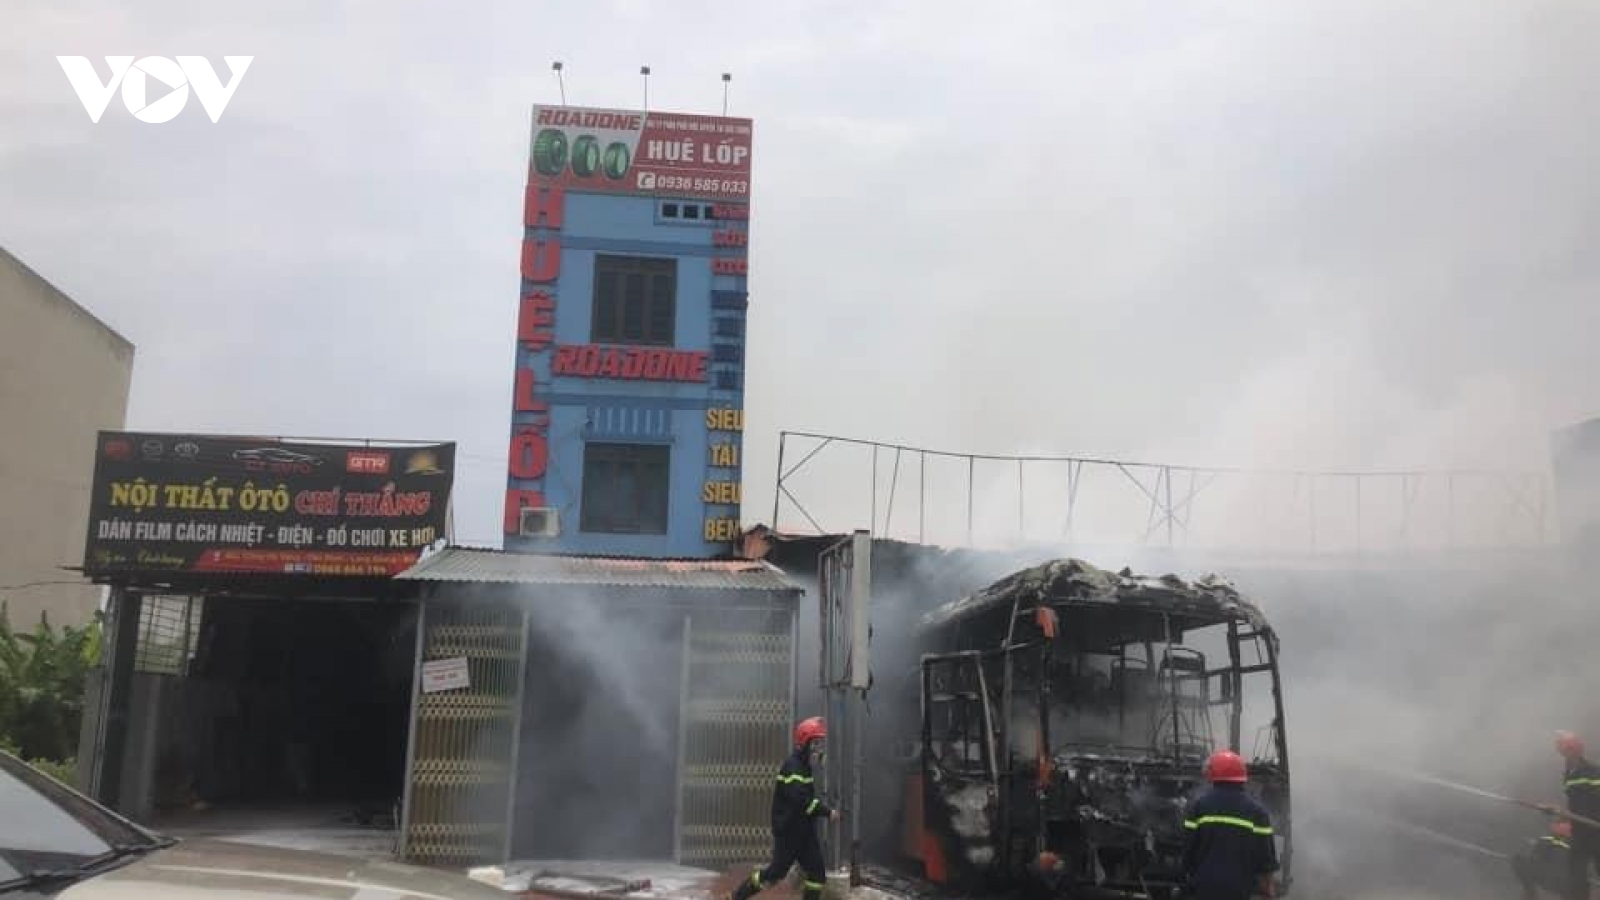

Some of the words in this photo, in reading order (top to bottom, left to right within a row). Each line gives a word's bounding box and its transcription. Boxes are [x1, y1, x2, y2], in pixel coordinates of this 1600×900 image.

[537, 109, 642, 131] ROADONE
[702, 138, 748, 166] LỐP
[693, 177, 720, 191] 585
[721, 180, 747, 194] 033
[554, 345, 710, 384] ROADONE
[109, 478, 158, 514] NỘI
[164, 476, 234, 512] THẤT
[240, 483, 291, 512] ÔTÔ
[294, 485, 341, 515] CHÍ
[98, 519, 133, 541] DÁN
[136, 524, 171, 541] FILM
[175, 520, 216, 542] CÁCH
[221, 522, 265, 548] NHIỆT
[278, 523, 312, 548] ĐIỆN
[351, 528, 385, 546] CHƠI
[389, 529, 408, 546] XE
